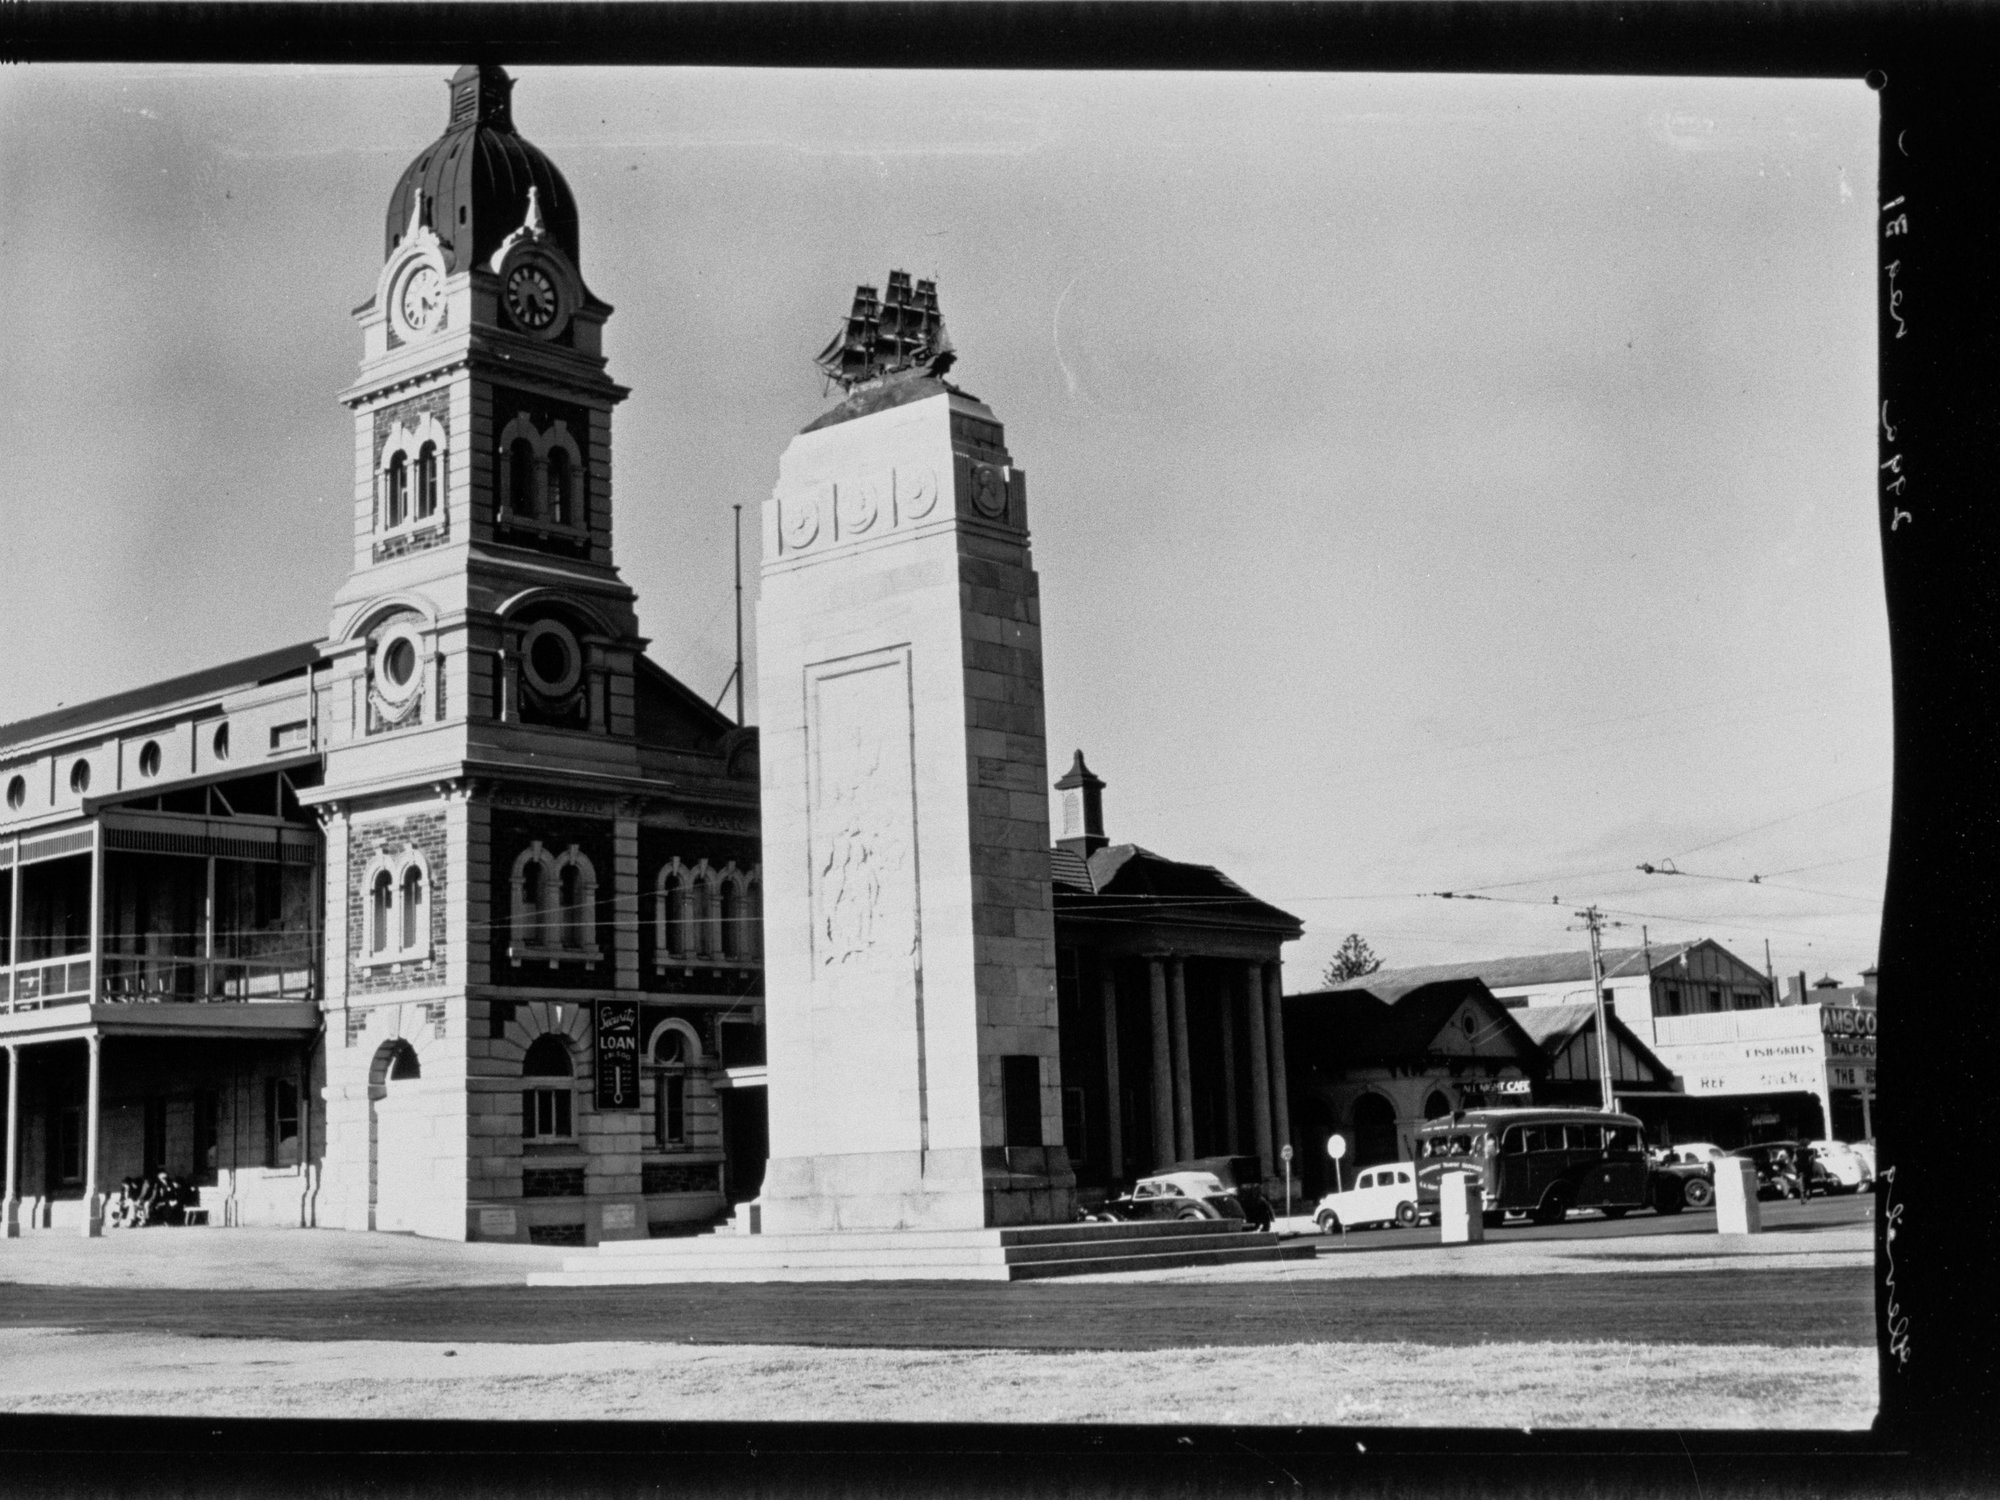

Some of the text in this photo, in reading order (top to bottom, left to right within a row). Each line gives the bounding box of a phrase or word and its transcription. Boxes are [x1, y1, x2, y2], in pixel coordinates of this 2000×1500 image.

[1822, 1008, 1877, 1034] AMSCO
[600, 1036, 635, 1050] LOAN
[1835, 1068, 1855, 1084] THE
